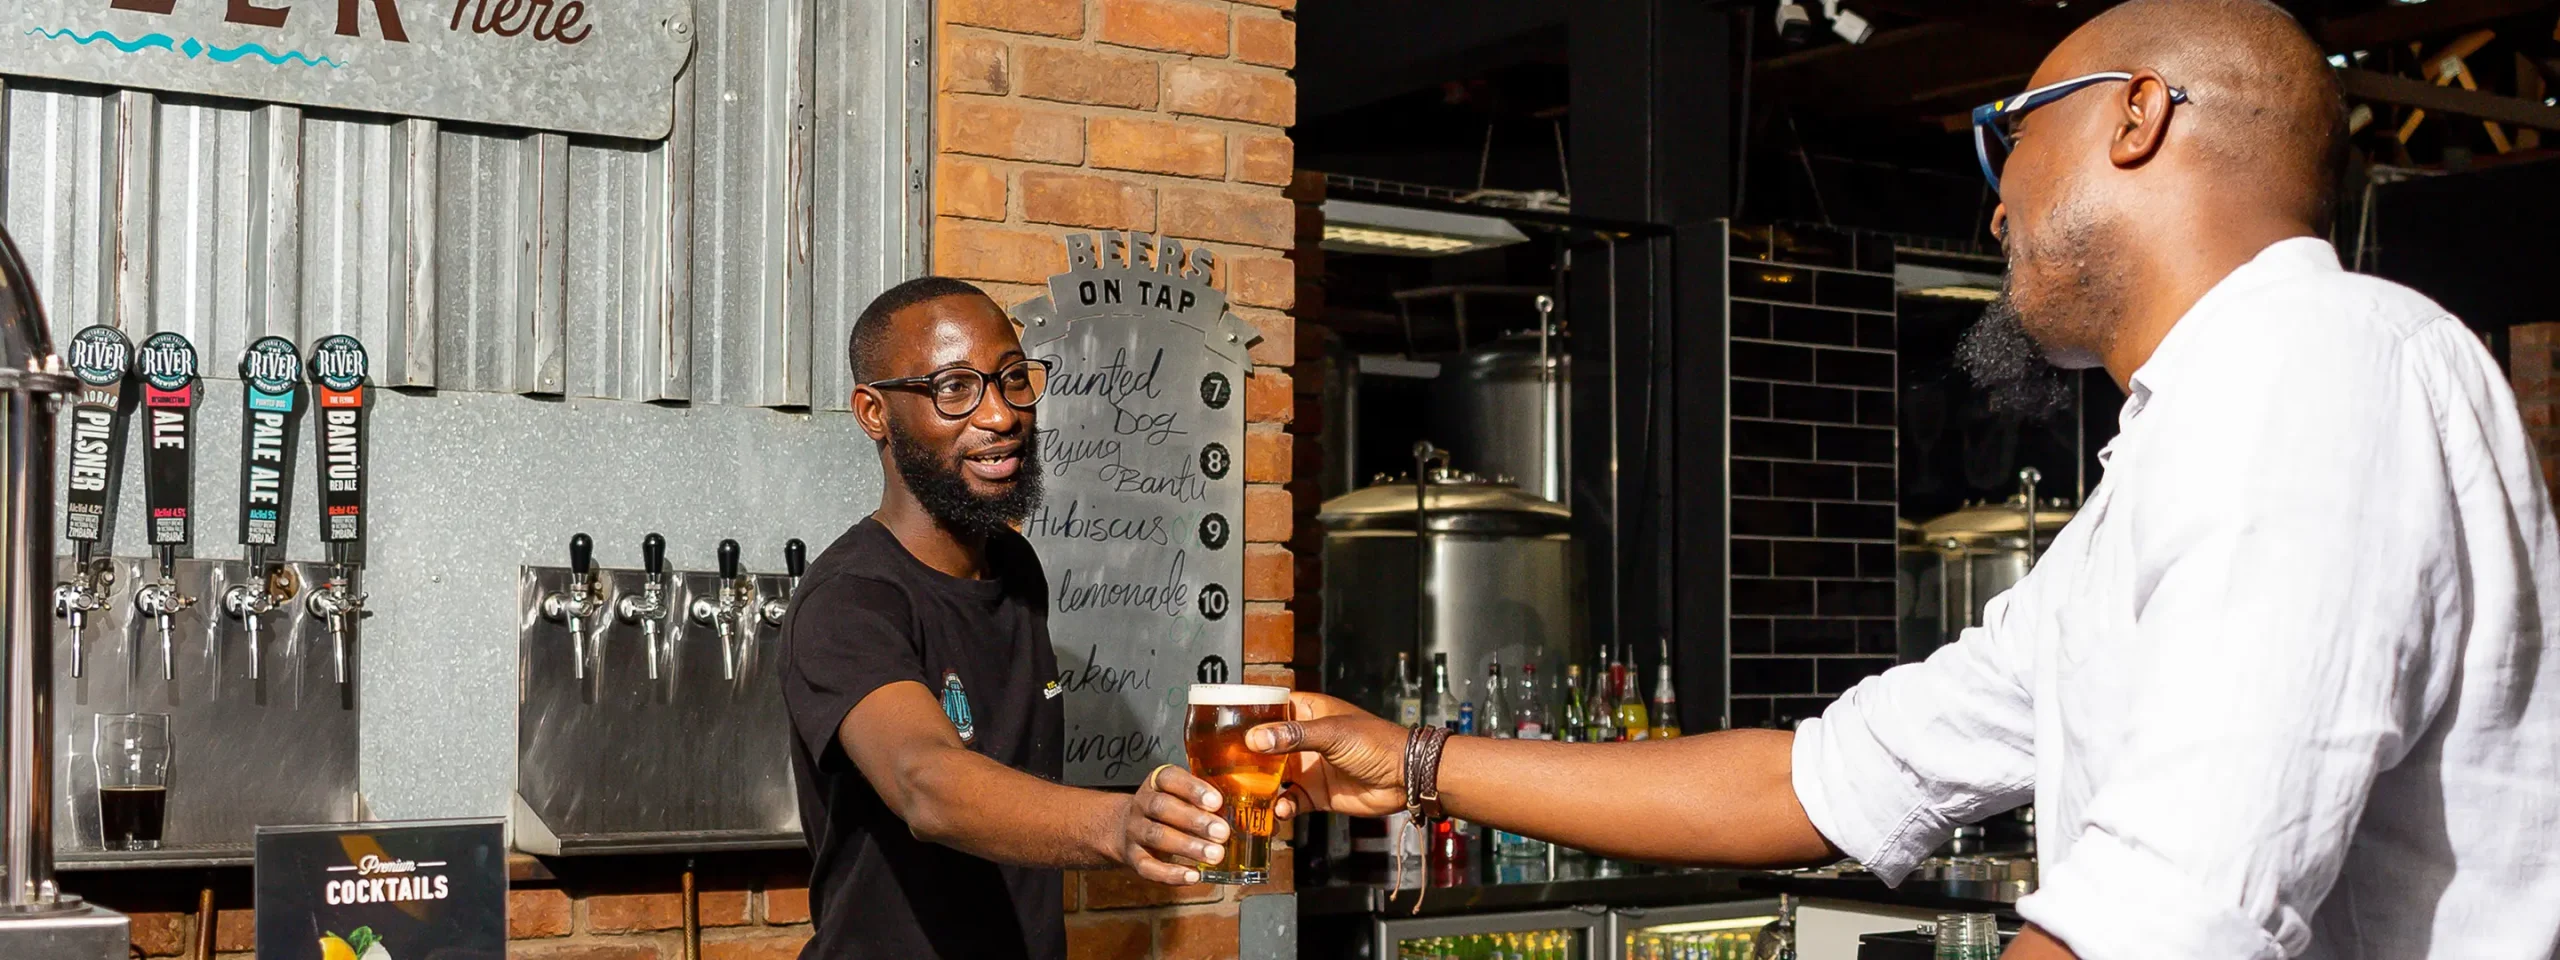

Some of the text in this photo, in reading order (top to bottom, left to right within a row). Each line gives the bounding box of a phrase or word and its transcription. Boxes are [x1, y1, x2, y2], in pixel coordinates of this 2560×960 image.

[1065, 231, 1216, 286] BEERS
[1078, 279, 1196, 314] ON TAP
[72, 340, 125, 372] RIVER
[143, 348, 194, 376] RIVER
[249, 351, 297, 381] RIVER
[318, 350, 365, 377] RIVER
[77, 390, 118, 408] AOBAB
[1036, 347, 1188, 446] Painted Dog
[154, 409, 184, 450] ALE
[252, 412, 284, 462] PALE
[71, 410, 111, 491] PILSNER
[1037, 424, 1207, 504] lying Bantu
[249, 466, 280, 505] ALE
[329, 480, 357, 491] RED ALE
[1057, 549, 1188, 617] lemonade
[1201, 590, 1226, 614] 10
[1060, 643, 1156, 694] akoni
[1066, 725, 1161, 780] inger
[357, 855, 416, 876] Premium
[326, 875, 449, 905] COCKTAILS
